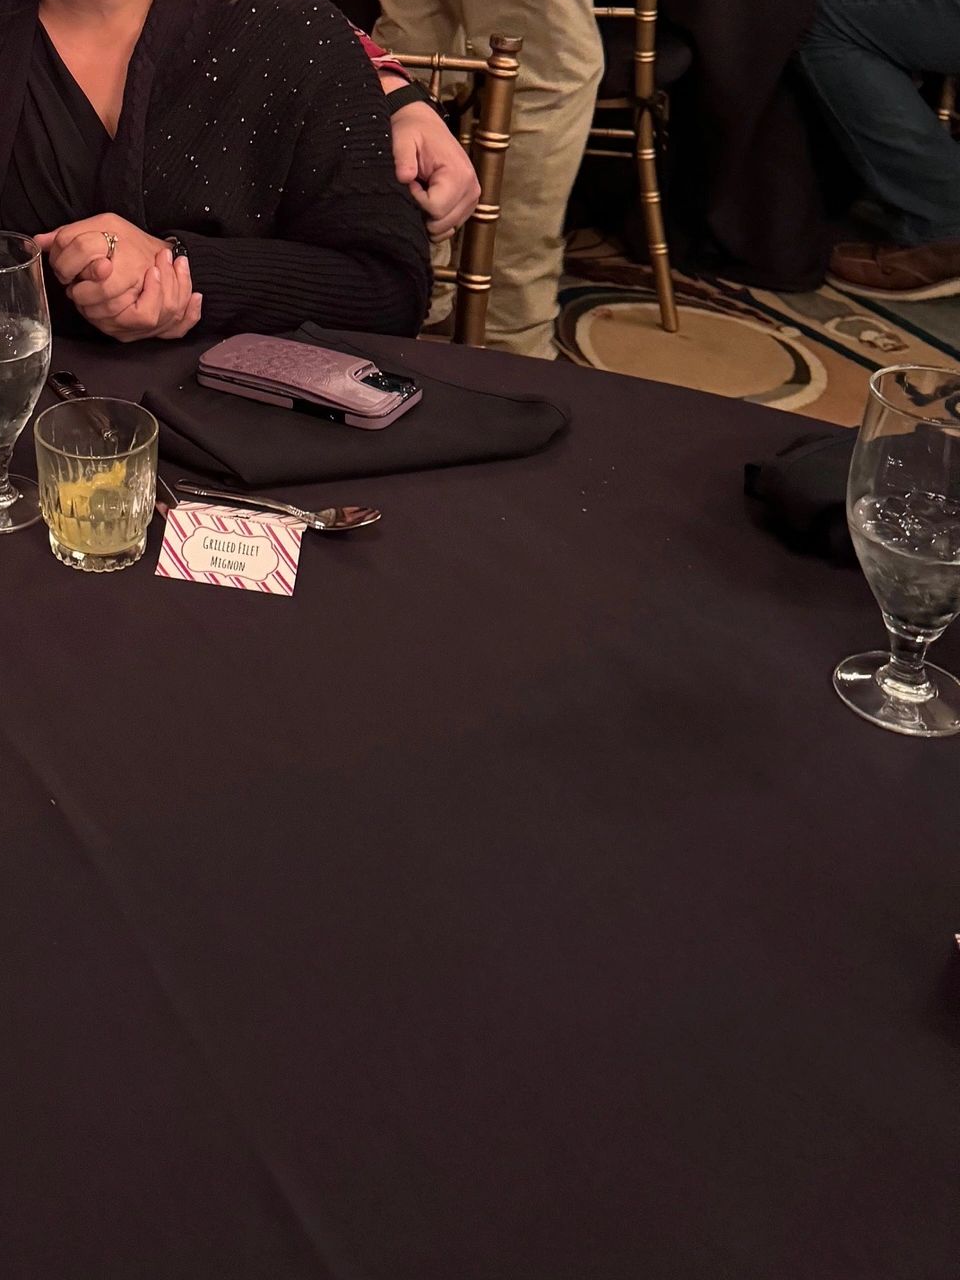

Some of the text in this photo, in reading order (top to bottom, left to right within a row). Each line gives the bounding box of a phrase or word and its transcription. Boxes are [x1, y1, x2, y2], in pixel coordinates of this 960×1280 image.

[202, 536, 259, 557] GRILLED FILET
[210, 556, 246, 572] MIGNON
